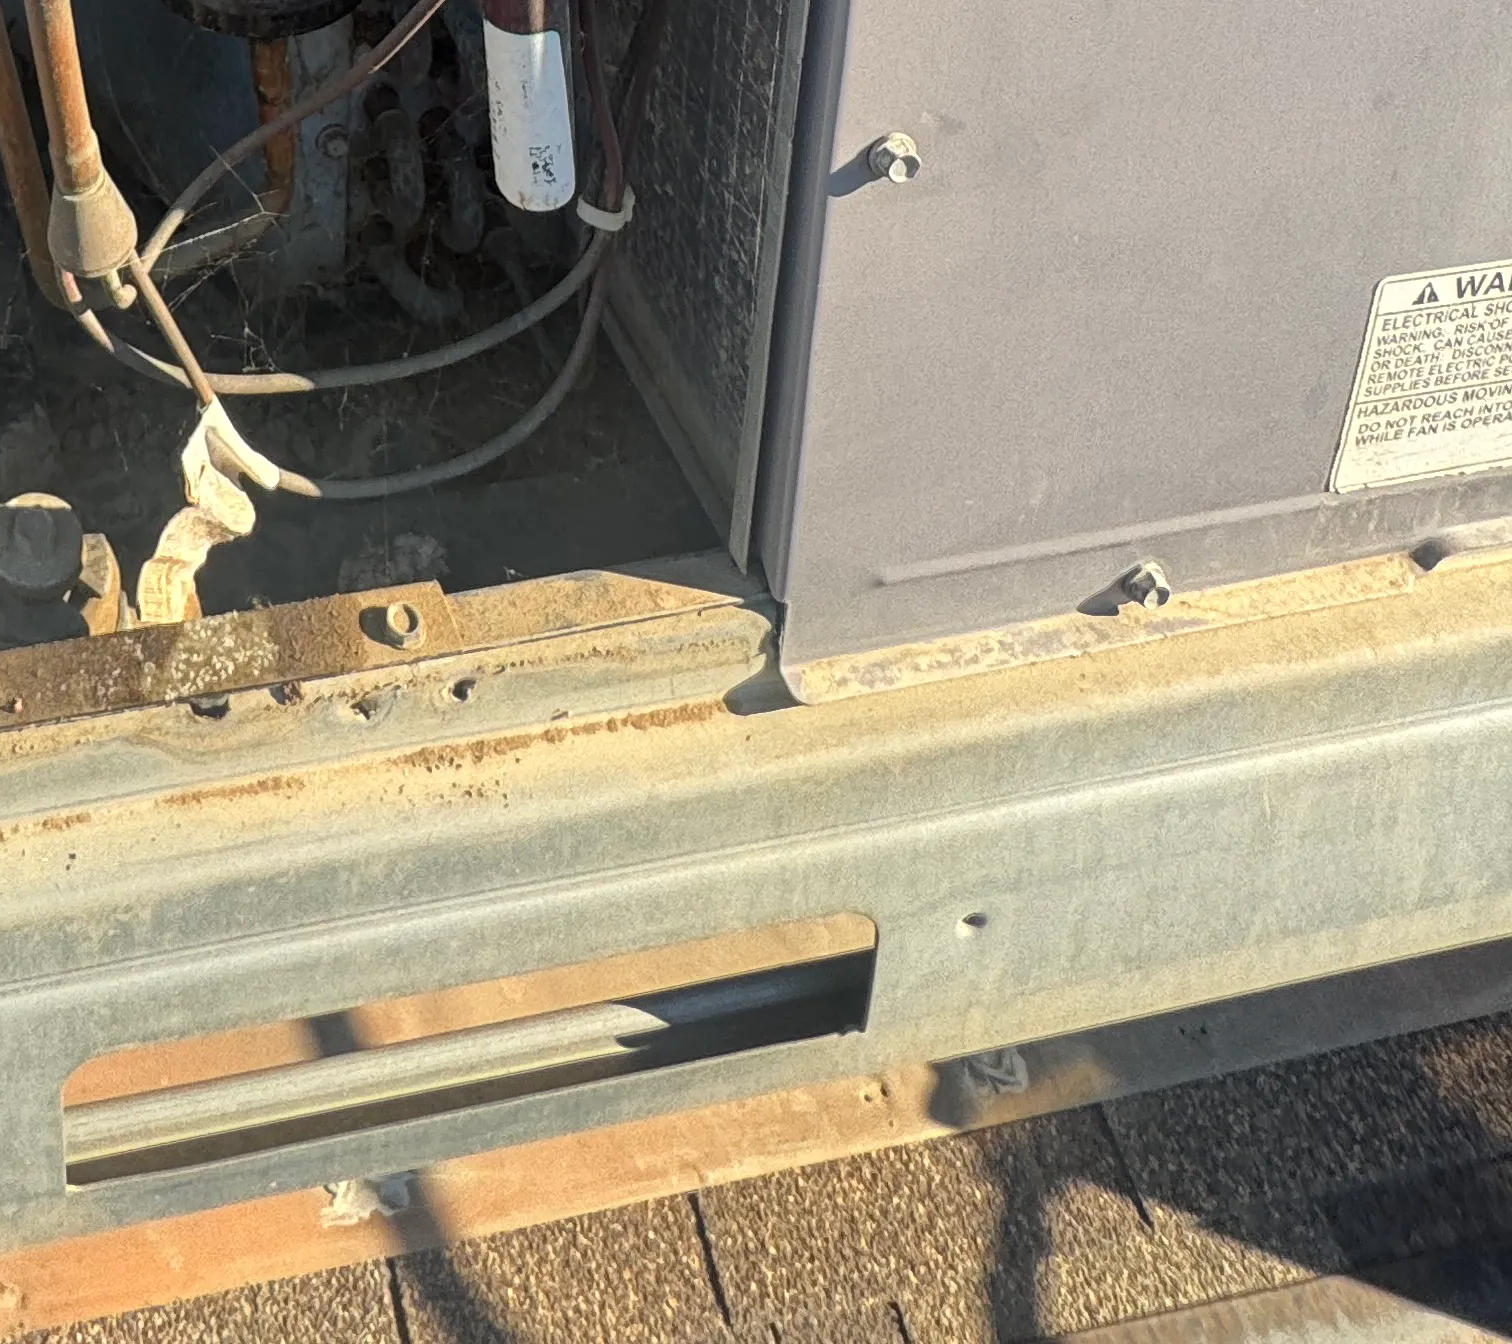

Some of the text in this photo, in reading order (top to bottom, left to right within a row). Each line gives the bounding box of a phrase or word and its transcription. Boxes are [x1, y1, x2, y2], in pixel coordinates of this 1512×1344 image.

[1456, 272, 1512, 299] WA
[1381, 306, 1479, 332] ELECTRICAL
[1454, 320, 1485, 335] RISK
[1488, 317, 1509, 330] OF
[1433, 336, 1463, 351] CAN
[1367, 366, 1424, 385] REMOTE
[1428, 355, 1495, 376] ELECTRIC
[1370, 359, 1391, 373] OR
[1363, 377, 1430, 397] SUPPLIES
[1434, 368, 1489, 387] BEFORE
[1357, 391, 1458, 419] HAZARDOUS
[1358, 399, 1512, 434] DO NOT REACH INTO
[1355, 429, 1404, 447] WHILE
[1407, 423, 1438, 438] FAN
[1442, 420, 1456, 432] IS
